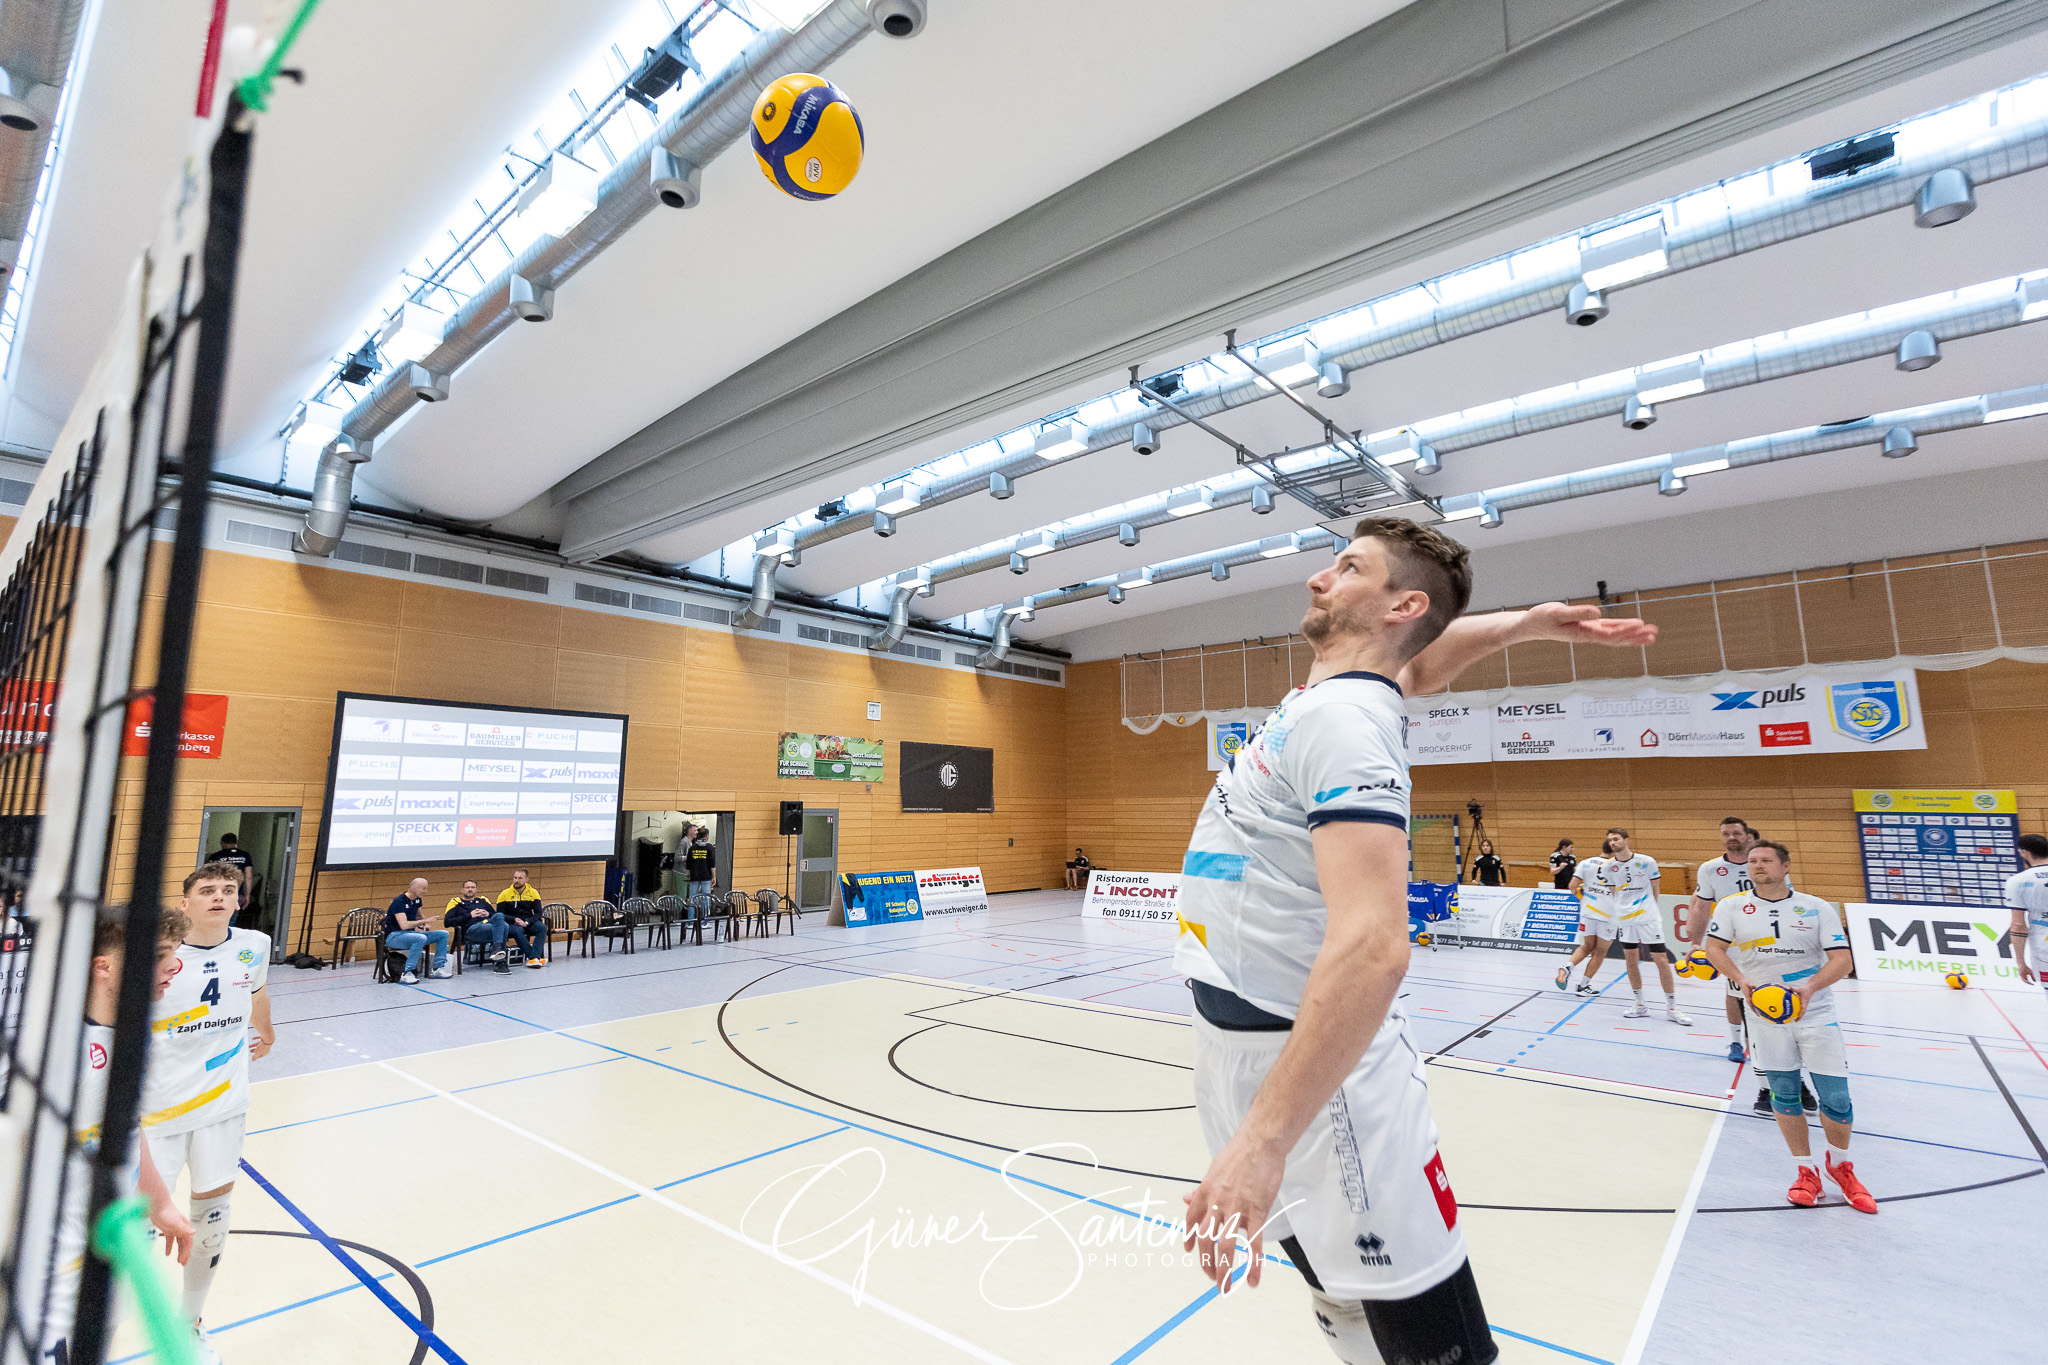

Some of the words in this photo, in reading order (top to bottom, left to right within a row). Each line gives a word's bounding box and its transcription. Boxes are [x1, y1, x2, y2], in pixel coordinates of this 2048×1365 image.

[1761, 683, 1806, 708] puls
[1428, 708, 1459, 719] SPECK
[1497, 703, 1566, 716] MEYSEL
[1428, 716, 1461, 728] pumpen
[180, 731, 216, 742] rkasse
[537, 732, 576, 740] FUCHS
[178, 742, 211, 754] nberg
[475, 739, 515, 747] SERVICES
[1418, 743, 1473, 754] BROCKERHOF
[1507, 747, 1550, 755] SERVICES
[348, 759, 399, 769] FUCHS
[468, 764, 517, 773] MEYSEL
[549, 766, 573, 778] puls
[578, 769, 619, 779] maxit
[362, 795, 394, 810] puls
[400, 797, 456, 809] maxit
[573, 793, 608, 803] SPECK
[396, 823, 441, 833] SPECK
[476, 827, 509, 835] Sparkasse
[475, 833, 506, 841] Nürnberg
[883, 876, 895, 885] EIN
[920, 872, 980, 888] schweiger
[1096, 874, 1149, 884] Ristorante
[1735, 879, 1754, 893] 10
[1092, 897, 1143, 907] Behringersdorfer
[1144, 899, 1165, 908] Straße
[1166, 900, 1172, 908] 6
[1537, 904, 1579, 912] VERMIETUNG
[924, 903, 988, 916] www.schweiger.de
[1102, 908, 1117, 917] fon
[1119, 908, 1158, 920] 0911/50
[1161, 911, 1173, 920] 57
[1534, 913, 1577, 921] VERWALTUNG
[1770, 920, 1781, 939] 1
[1528, 932, 1569, 941] BEWERTUNG
[1876, 957, 1986, 976] ZIMMEREI
[200, 977, 221, 1006] 4
[177, 1021, 202, 1034] Zapf
[204, 1015, 243, 1028] Daigfuss
